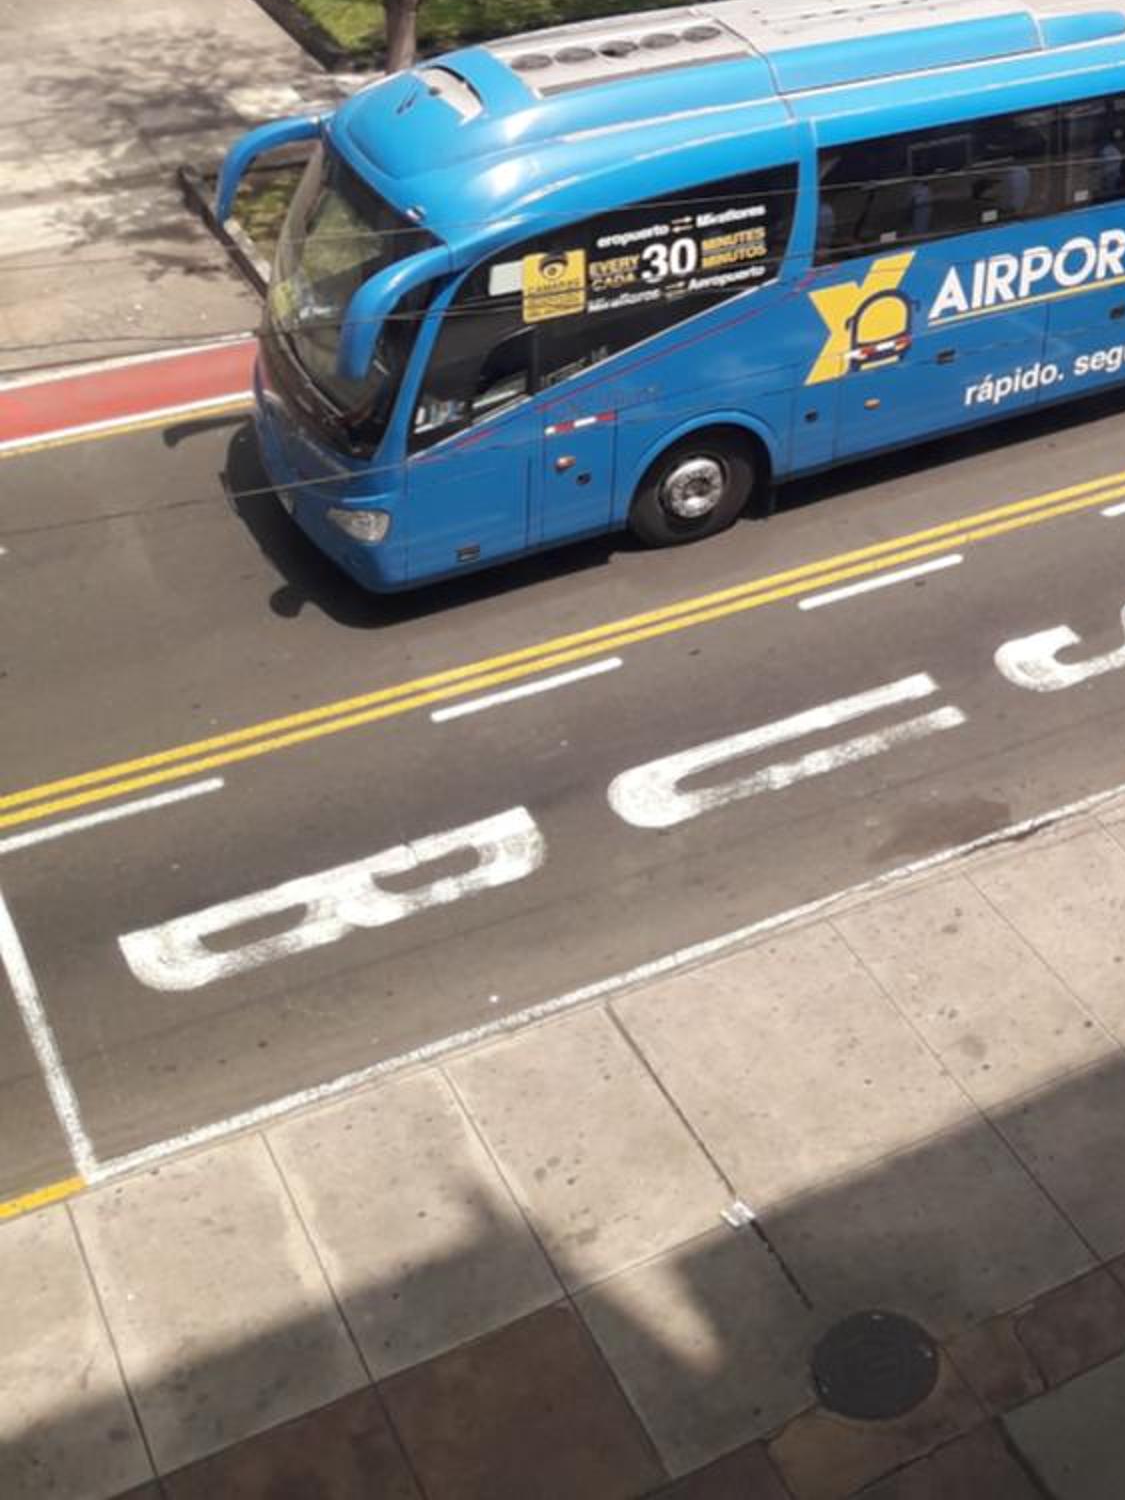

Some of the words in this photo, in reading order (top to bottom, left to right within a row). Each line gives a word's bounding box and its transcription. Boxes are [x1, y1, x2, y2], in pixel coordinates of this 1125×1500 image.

[701, 226, 767, 250] MINUTES
[589, 254, 640, 277] EVERY
[640, 237, 699, 284] 30
[701, 244, 768, 270] MINUTOS
[591, 272, 637, 291] CADA
[963, 359, 1065, 408] rápido.
